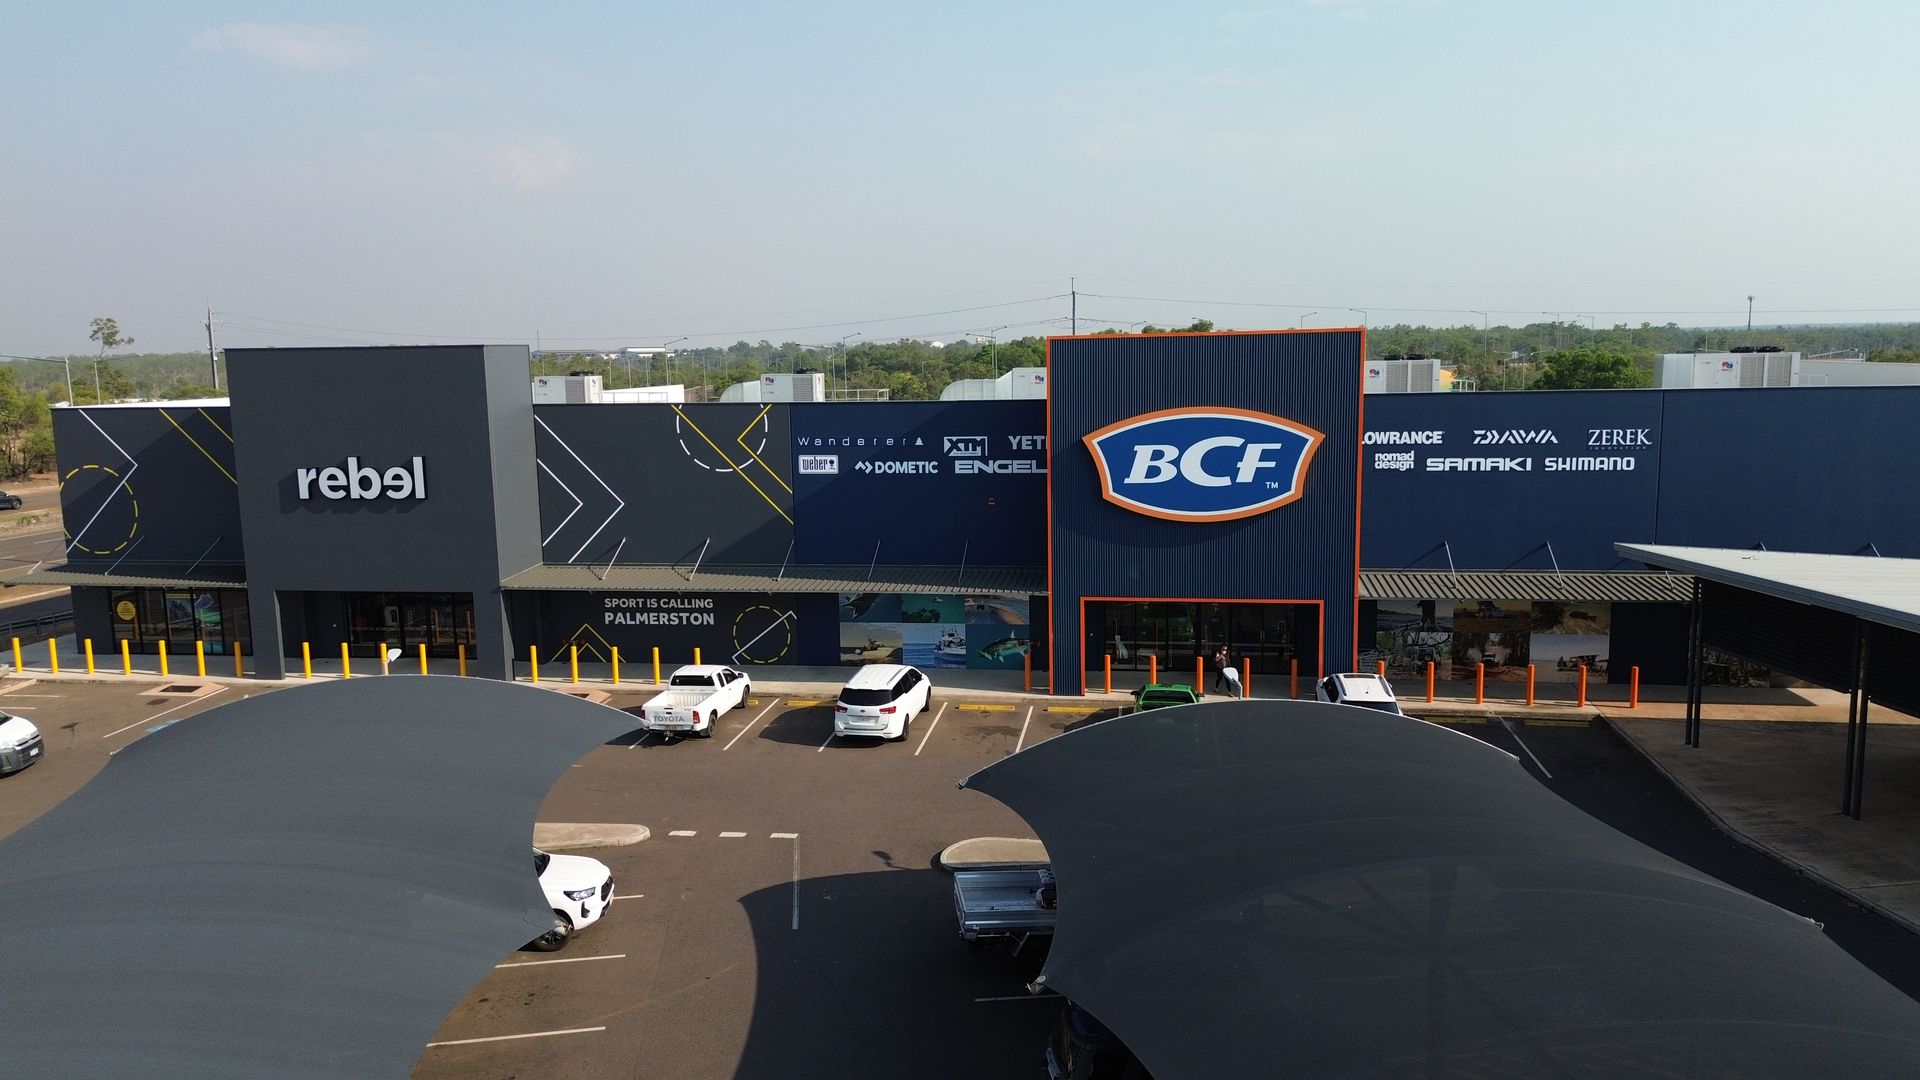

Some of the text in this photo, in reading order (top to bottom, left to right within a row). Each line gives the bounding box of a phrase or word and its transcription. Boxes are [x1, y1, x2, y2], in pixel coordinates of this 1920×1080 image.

[797, 436, 906, 446] Wanderer
[1473, 430, 1559, 444] DAIWA
[1587, 428, 1653, 445] ZEREK
[944, 436, 988, 457] XTM
[1123, 435, 1282, 487] BCF
[1375, 450, 1415, 461] nomad
[802, 456, 828, 471] weber
[875, 461, 939, 474] DOMETIC
[955, 460, 1048, 474] ENGEL
[1374, 459, 1415, 471] design
[1426, 457, 1532, 471] SAMAKI
[1544, 457, 1636, 471] SHIMANO
[297, 456, 425, 500] rebel
[1265, 481, 1279, 489] TM
[604, 598, 714, 609] SPORT IS CALLING
[604, 612, 715, 625] PALMERSTON
